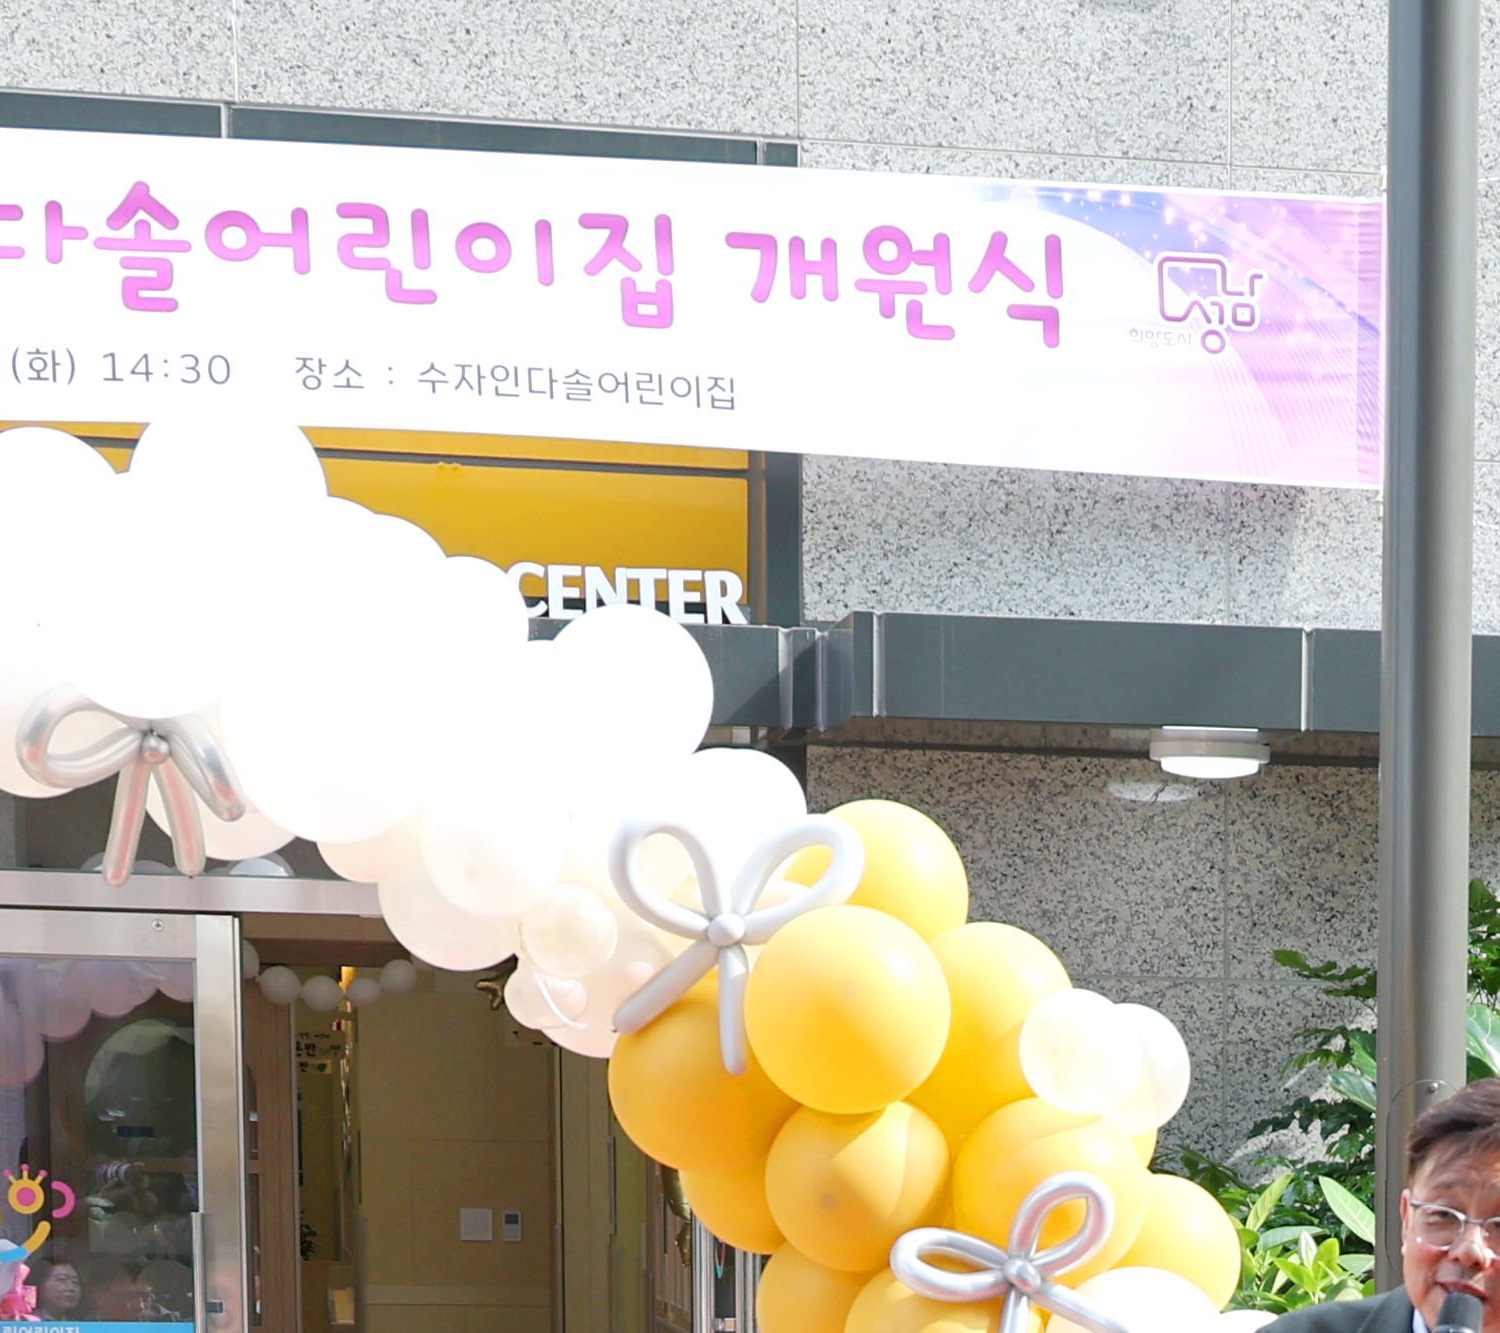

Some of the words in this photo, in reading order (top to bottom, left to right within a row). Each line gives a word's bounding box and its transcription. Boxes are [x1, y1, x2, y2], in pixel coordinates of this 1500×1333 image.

[726, 225, 1063, 348] 개원식
[102, 352, 231, 385] 14:30
[295, 356, 365, 391] 장소
[417, 362, 736, 411] 수자인다솔어린이집
[506, 561, 747, 625] CENTER
